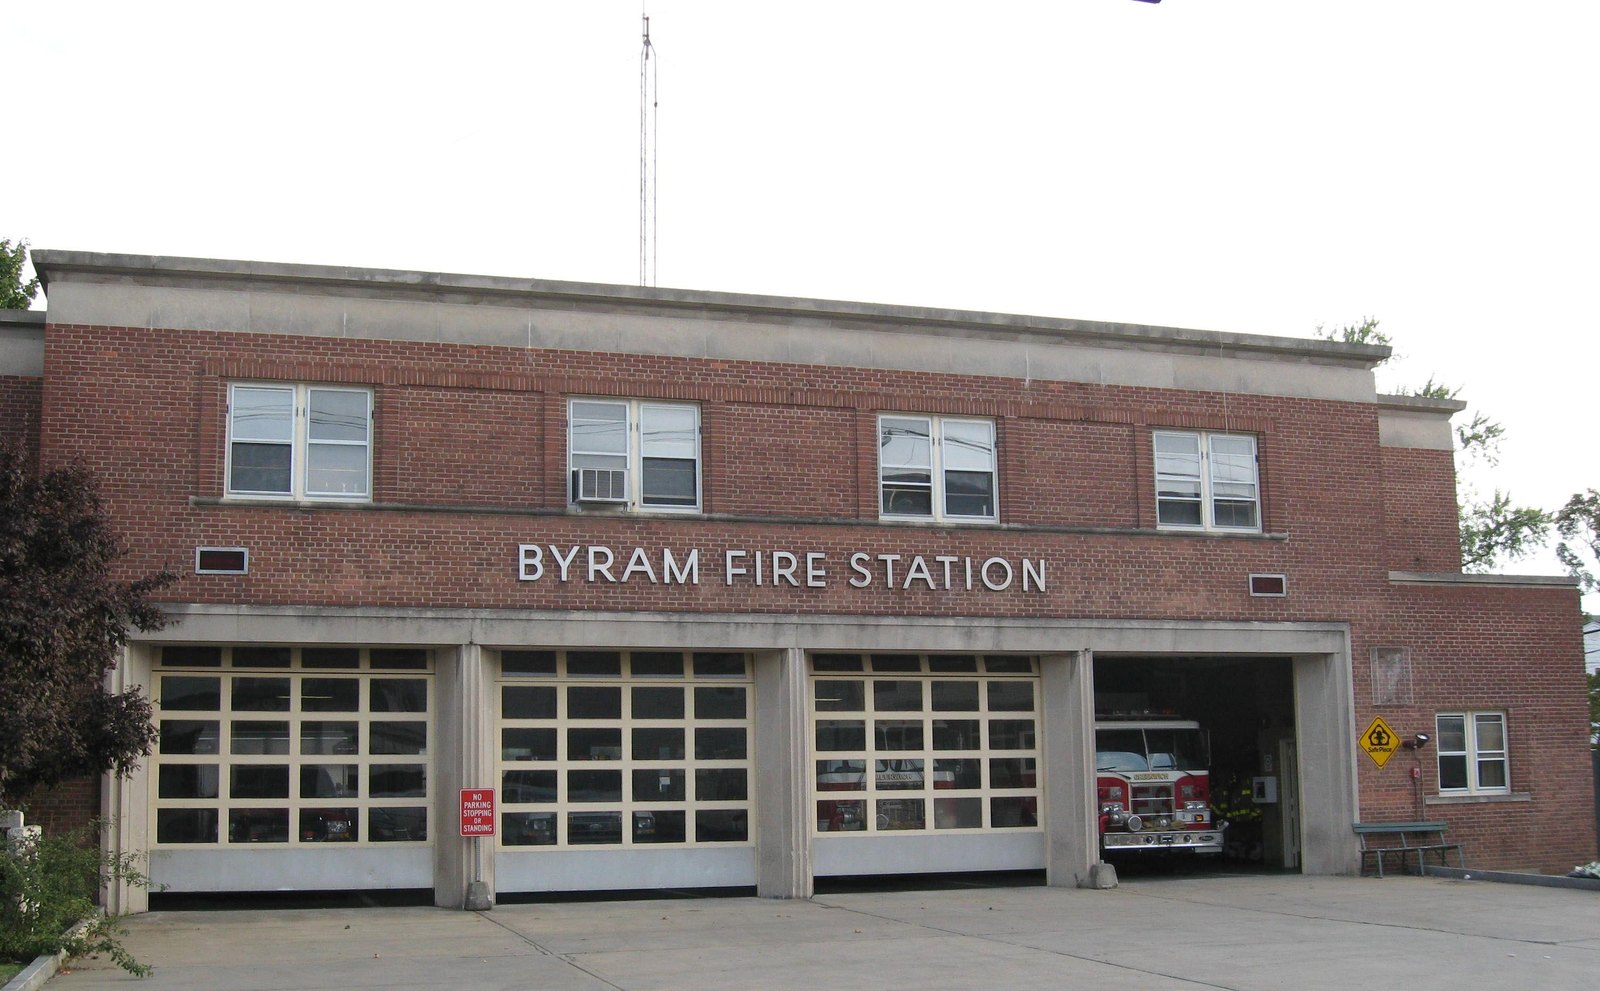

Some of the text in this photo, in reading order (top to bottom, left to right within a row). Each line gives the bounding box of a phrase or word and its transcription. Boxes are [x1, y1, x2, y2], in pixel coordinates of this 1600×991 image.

[518, 544, 1046, 592] BYRAM FIRE STATION
[463, 801, 492, 809] PARKING
[463, 809, 492, 817] STOPPING
[463, 824, 493, 832] STANDING
